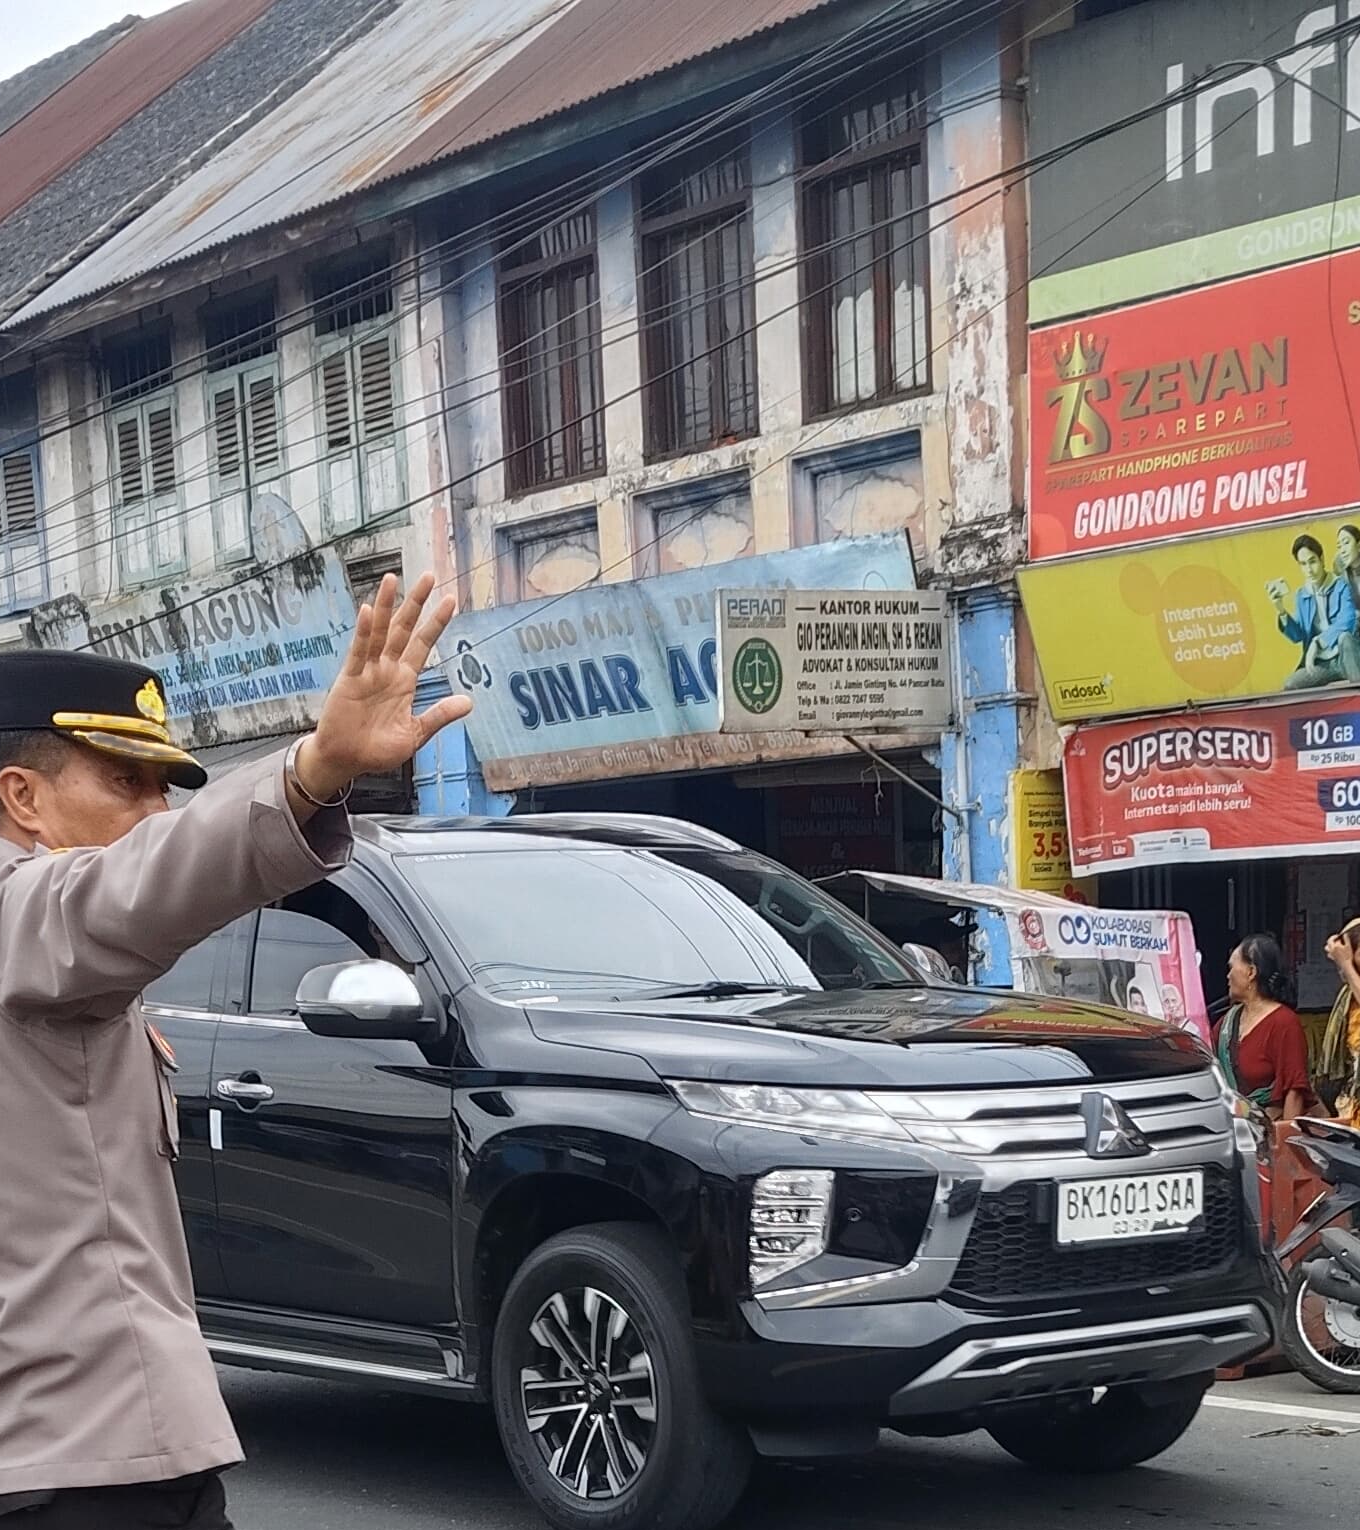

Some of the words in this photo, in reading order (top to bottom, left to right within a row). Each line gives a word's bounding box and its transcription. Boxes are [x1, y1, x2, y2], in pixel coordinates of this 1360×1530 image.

[1118, 336, 1288, 421] ZEVAN
[1120, 398, 1289, 447] SPAREPART
[1116, 448, 1199, 478] HANDPHONE
[1074, 480, 1207, 539] GONDRONG
[1212, 460, 1308, 514] PONSEL
[192, 586, 303, 648] AGUNG
[727, 598, 785, 616] PERADI
[819, 600, 872, 616] KANTOR
[875, 600, 920, 616] HUKUM
[1163, 600, 1238, 624] Internetan
[514, 617, 578, 653] TOKO
[797, 622, 813, 652] GIO
[814, 622, 859, 651] PERANGIN
[892, 621, 904, 650] SH
[914, 622, 943, 650] REKAN
[1168, 625, 1207, 643] Lebih
[1209, 621, 1243, 638] Luas
[1175, 648, 1202, 663] dan
[1203, 640, 1247, 661] Cepat
[802, 658, 844, 673] ADVOKAT
[846, 657, 853, 672] &
[855, 656, 905, 672] KONSULTAN
[908, 656, 939, 671] HUKUM
[231, 681, 260, 702] BUNGA
[259, 676, 281, 698] DAN
[508, 653, 654, 731] SINAR
[1060, 682, 1107, 700] indosat
[1302, 719, 1329, 746] 10
[1332, 725, 1354, 743] GB
[602, 747, 649, 768] Ginting
[728, 735, 754, 753] 061
[1321, 753, 1332, 764] 25
[1334, 752, 1355, 762] Ribu
[1131, 783, 1175, 802] Kuota
[1175, 783, 1203, 797] makin
[1205, 780, 1244, 798] banyak
[1124, 801, 1180, 820] Internetan
[1197, 799, 1222, 813] lebih
[1223, 796, 1252, 810] seru!
[1091, 915, 1152, 935] KOLABORASI
[1130, 937, 1169, 951] BERKAH
[1067, 1186, 1094, 1220] BK
[1096, 1182, 1151, 1217] 1601
[1156, 1178, 1196, 1212] SAA
